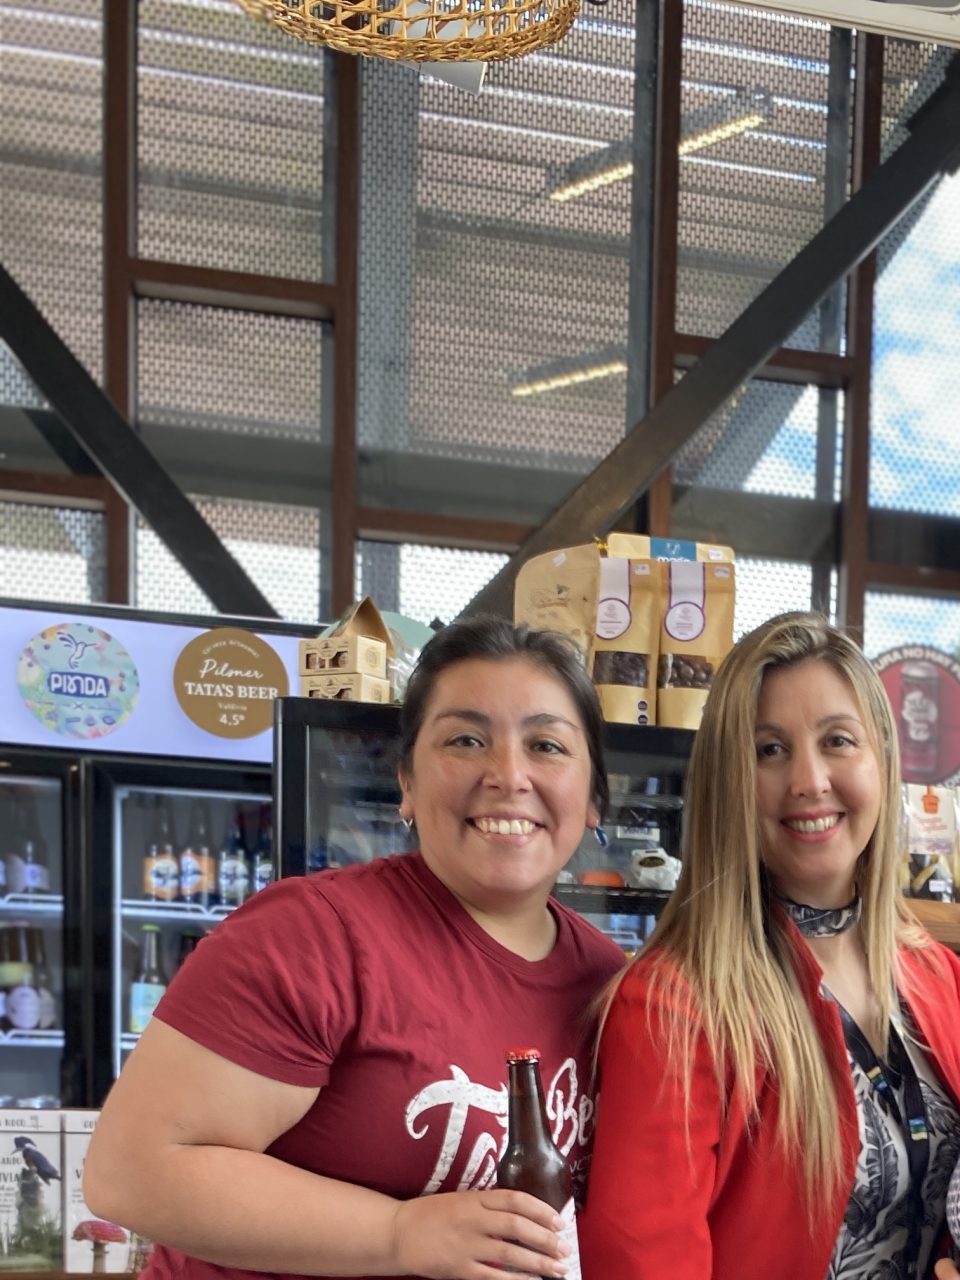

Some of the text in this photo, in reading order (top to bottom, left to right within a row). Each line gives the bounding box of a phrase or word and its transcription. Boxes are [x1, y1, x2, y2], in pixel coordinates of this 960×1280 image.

[902, 647, 926, 660] NO
[199, 658, 264, 679] Pilsner
[184, 681, 279, 700] TATA'S BEER
